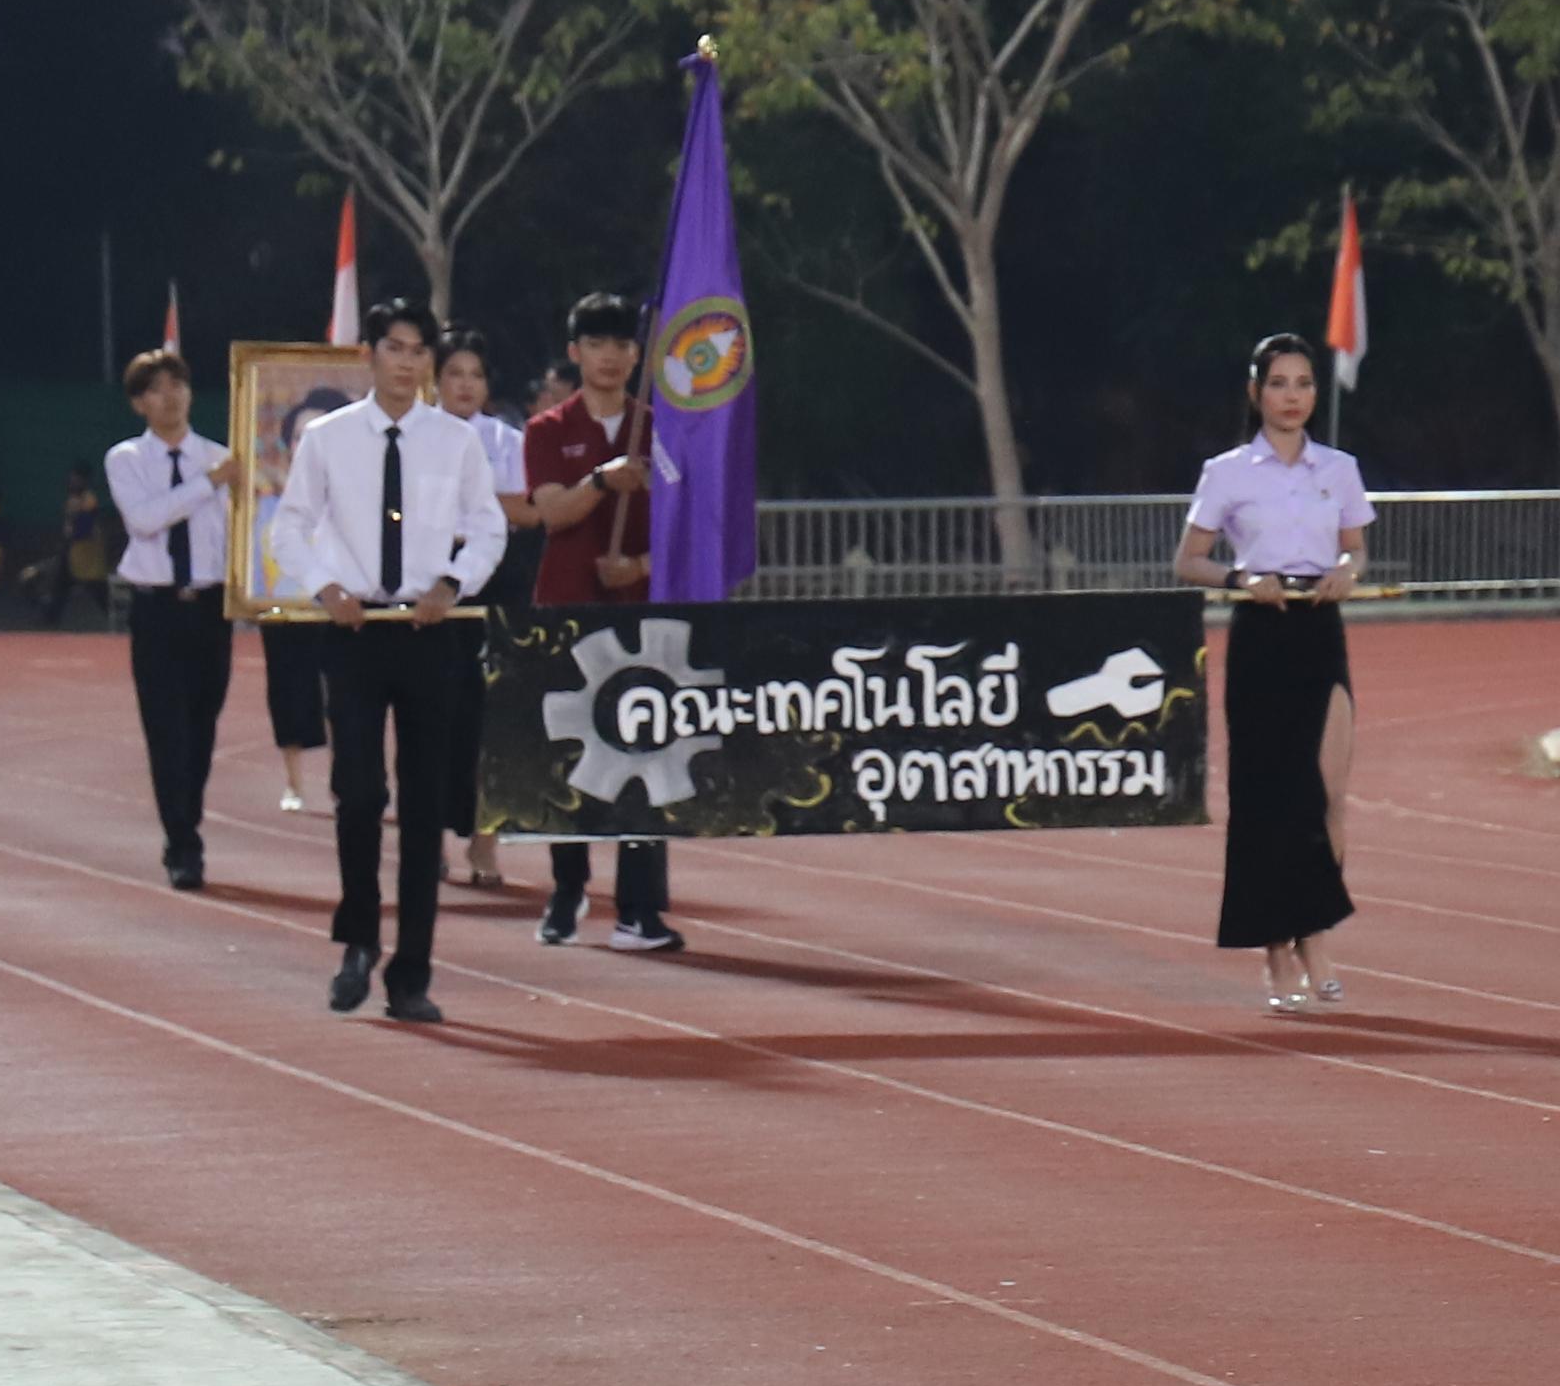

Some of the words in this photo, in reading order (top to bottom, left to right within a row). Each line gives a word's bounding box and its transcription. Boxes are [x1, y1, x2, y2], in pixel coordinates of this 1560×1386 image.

[617, 641, 1019, 744] คณะเทคโนโลยี
[852, 743, 1165, 821] อุตสาหกรรม
